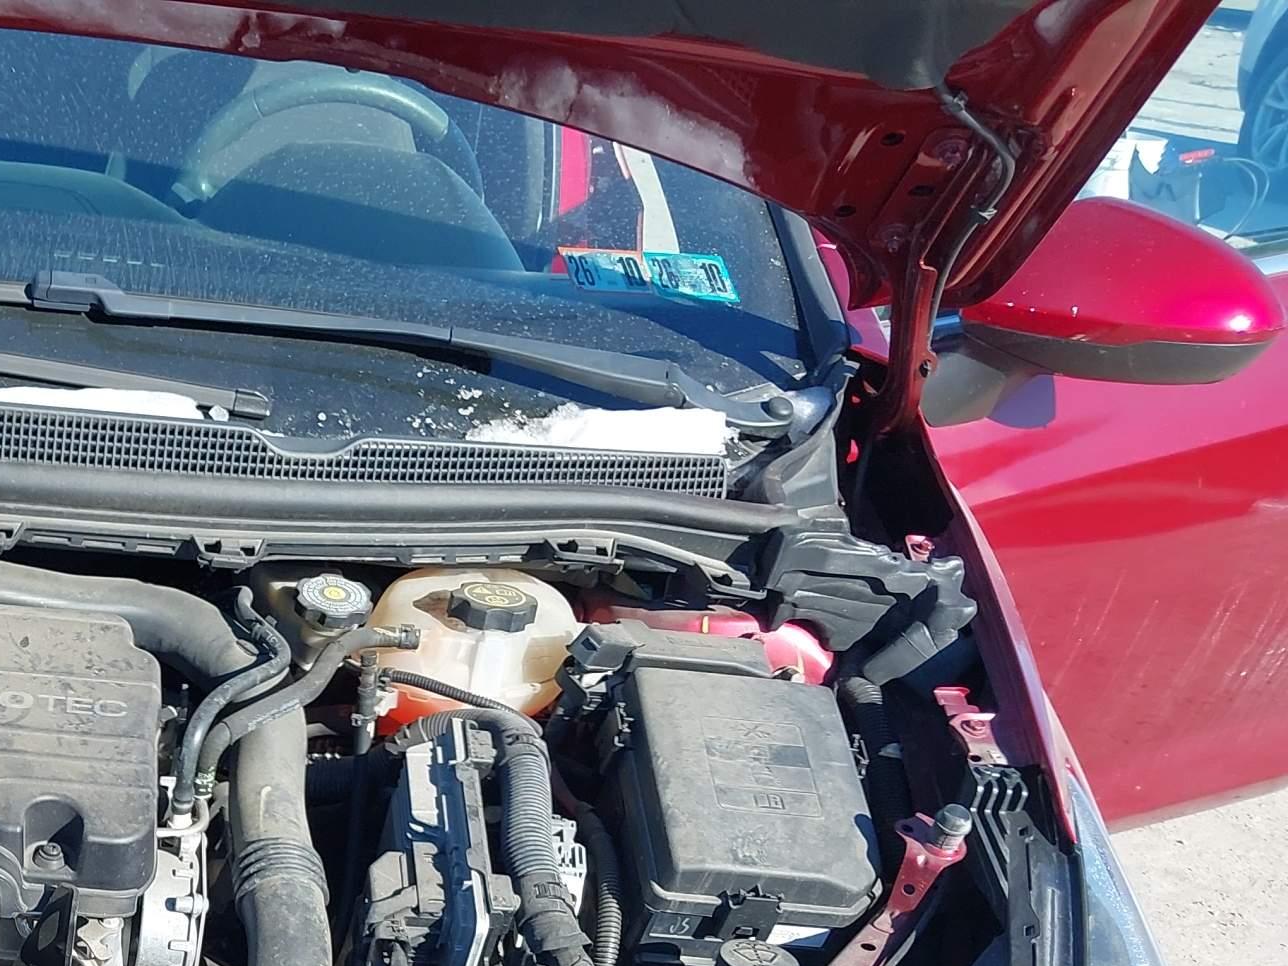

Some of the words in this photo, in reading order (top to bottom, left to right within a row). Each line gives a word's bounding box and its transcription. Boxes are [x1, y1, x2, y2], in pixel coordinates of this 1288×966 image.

[568, 255, 596, 287] 26
[616, 256, 648, 287] 10
[651, 257, 681, 290] 26
[699, 261, 729, 294] 10
